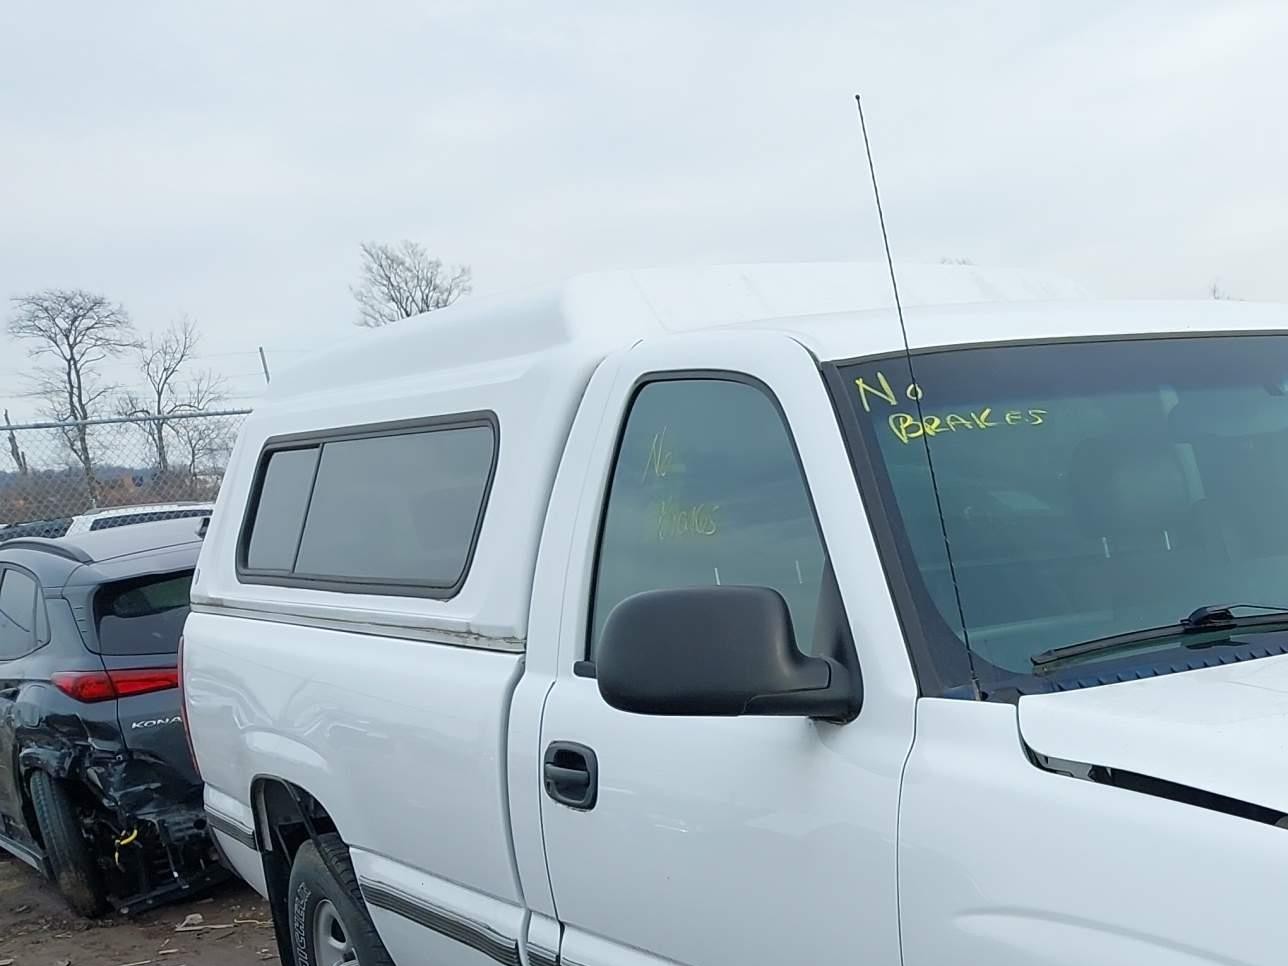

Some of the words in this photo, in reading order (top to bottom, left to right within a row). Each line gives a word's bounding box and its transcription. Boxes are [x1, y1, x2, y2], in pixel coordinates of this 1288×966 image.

[855, 371, 923, 412] No
[888, 407, 1049, 444] BRAKES
[131, 716, 183, 729] KONA
